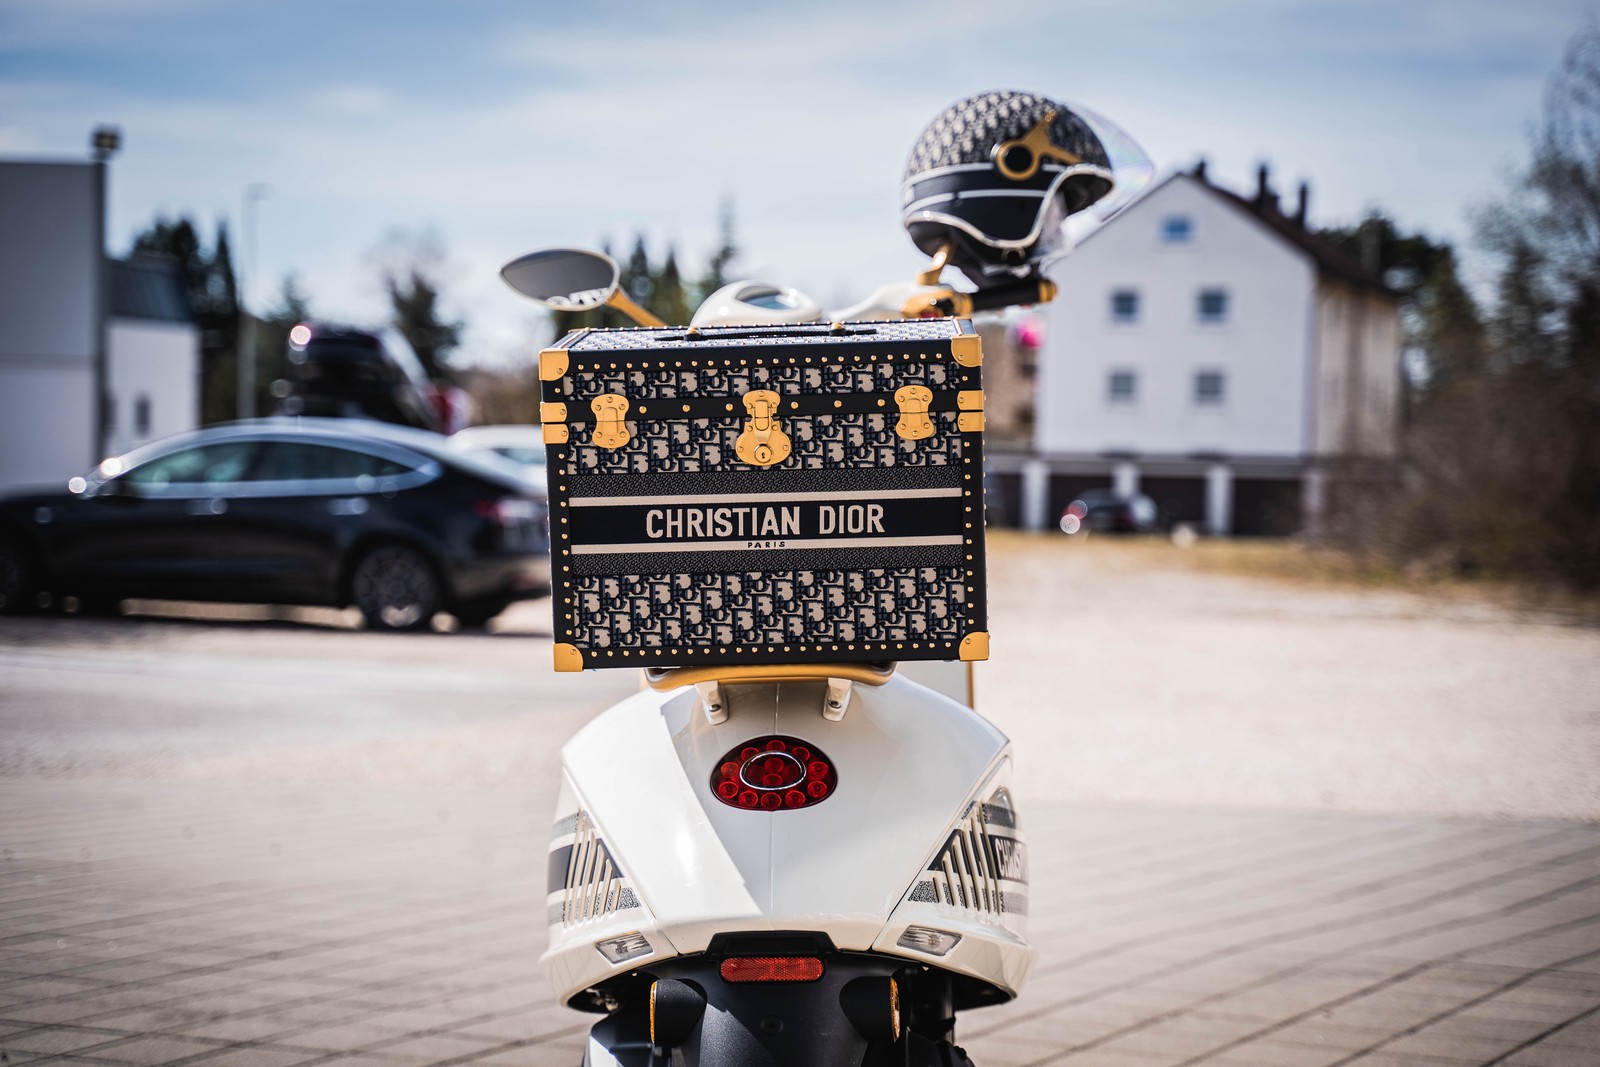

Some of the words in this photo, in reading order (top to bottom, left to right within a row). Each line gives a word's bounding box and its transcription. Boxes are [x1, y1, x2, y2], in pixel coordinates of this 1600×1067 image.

[646, 507, 800, 538] CHRISTIAN
[819, 504, 885, 534] DIOR
[748, 541, 786, 549] PARIS
